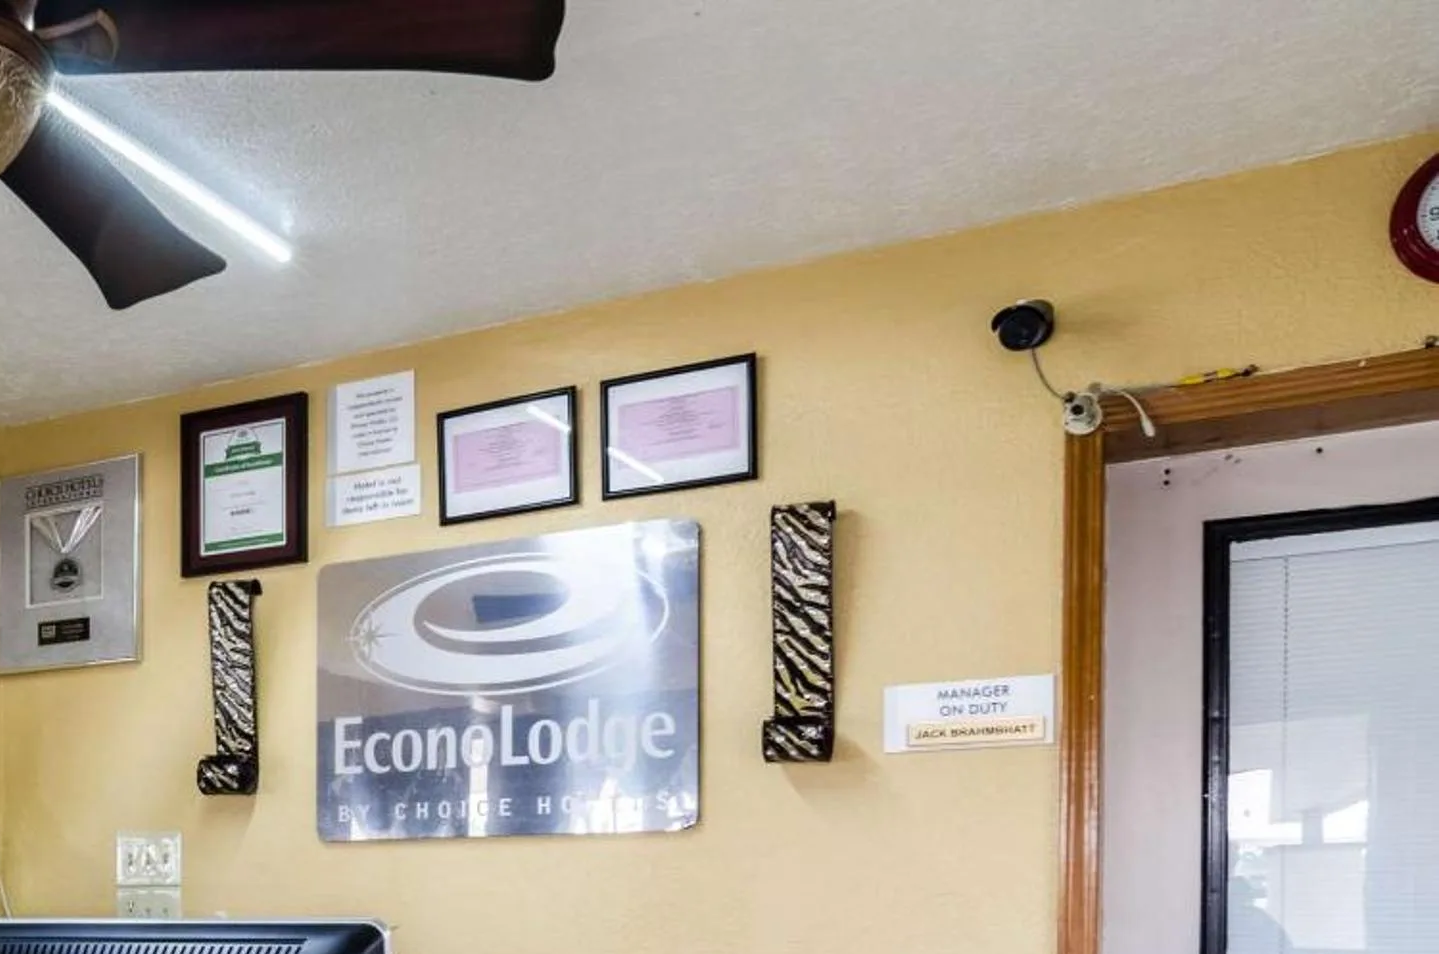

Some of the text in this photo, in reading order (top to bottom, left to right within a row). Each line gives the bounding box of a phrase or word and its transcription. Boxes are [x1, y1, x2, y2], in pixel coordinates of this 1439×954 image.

[936, 684, 1011, 701] MANAGER
[939, 702, 1008, 718] ON DUTY
[333, 699, 676, 776] EconoLodge
[914, 729, 948, 741] JACK
[337, 802, 371, 824] BY
[394, 797, 513, 822] CHOICE
